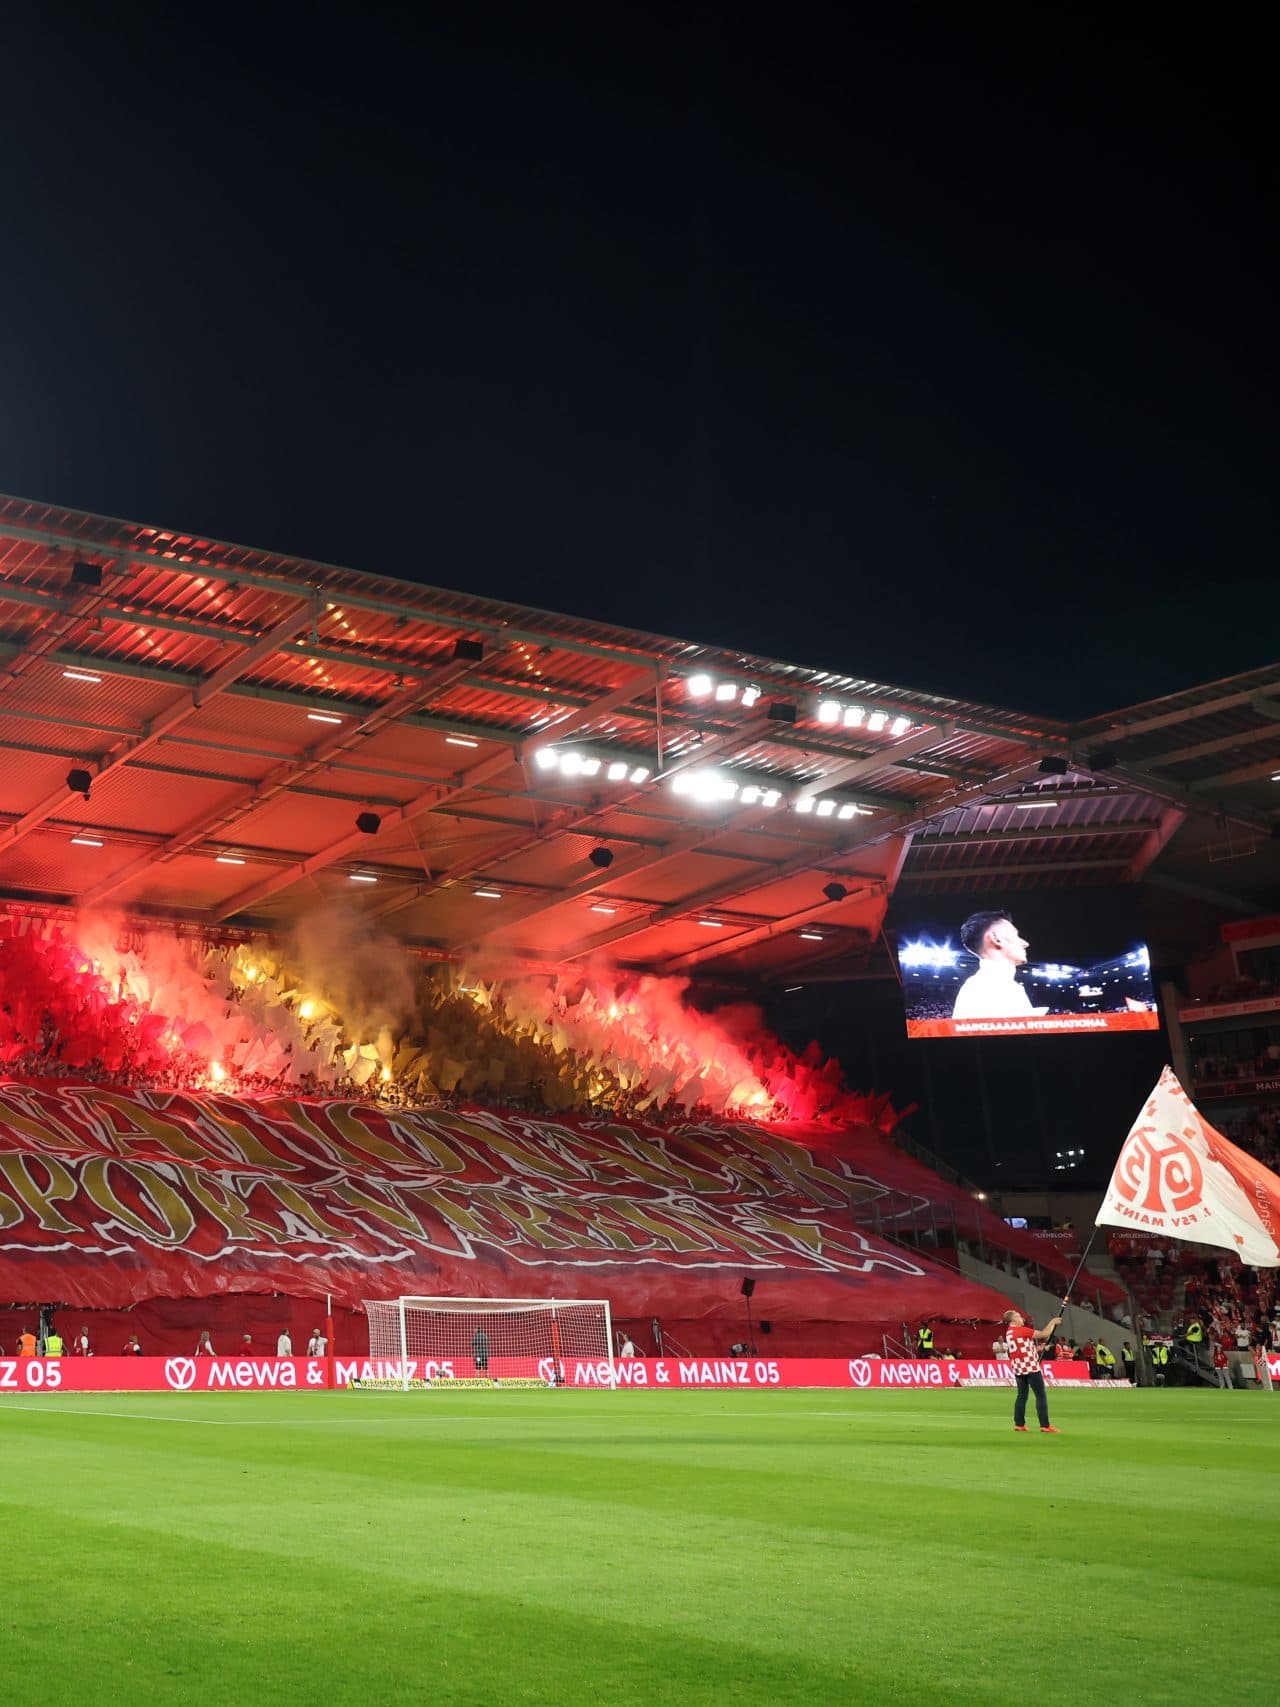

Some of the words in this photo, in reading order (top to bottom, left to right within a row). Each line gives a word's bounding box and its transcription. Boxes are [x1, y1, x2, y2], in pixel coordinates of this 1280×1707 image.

[1027, 1017, 1108, 1031] INTERNATIONAL
[26, 1360, 62, 1387] 05
[306, 1361, 323, 1385] &
[425, 1360, 455, 1380] 05
[655, 1362, 670, 1383] &
[679, 1362, 751, 1384] MAINZ
[754, 1361, 780, 1384] 05
[948, 1363, 960, 1383] &
[967, 1363, 1016, 1379] MAIN
